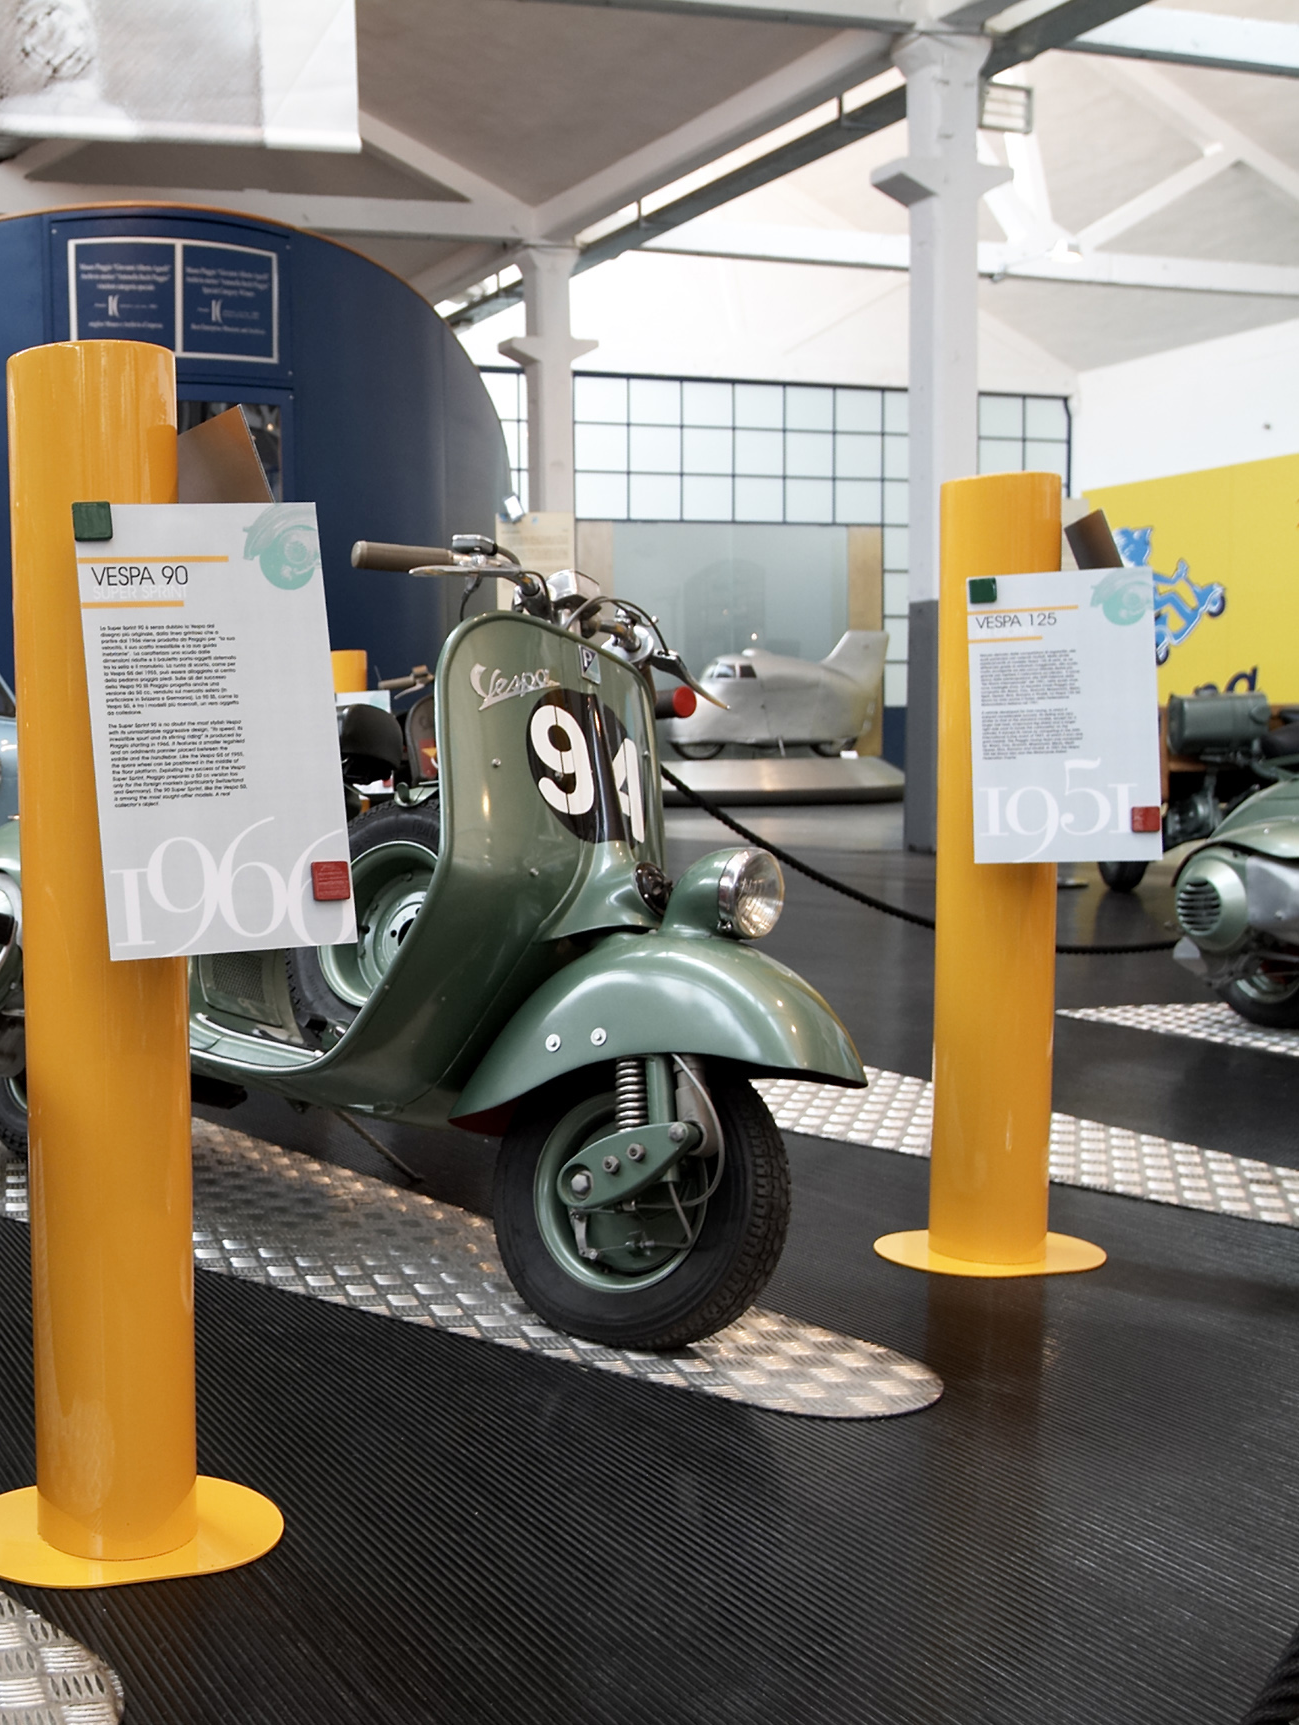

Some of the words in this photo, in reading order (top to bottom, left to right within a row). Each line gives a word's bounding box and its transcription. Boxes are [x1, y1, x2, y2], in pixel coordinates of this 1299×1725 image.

[91, 566, 155, 586] VESPA
[161, 565, 188, 585] 90
[92, 585, 137, 600] SUPER
[142, 585, 187, 599] SPRINT
[975, 615, 1022, 630] VESPA
[1028, 612, 1057, 627] 125
[470, 663, 560, 711] Vespa
[978, 757, 1138, 863] 1951
[110, 816, 357, 957] 1966
